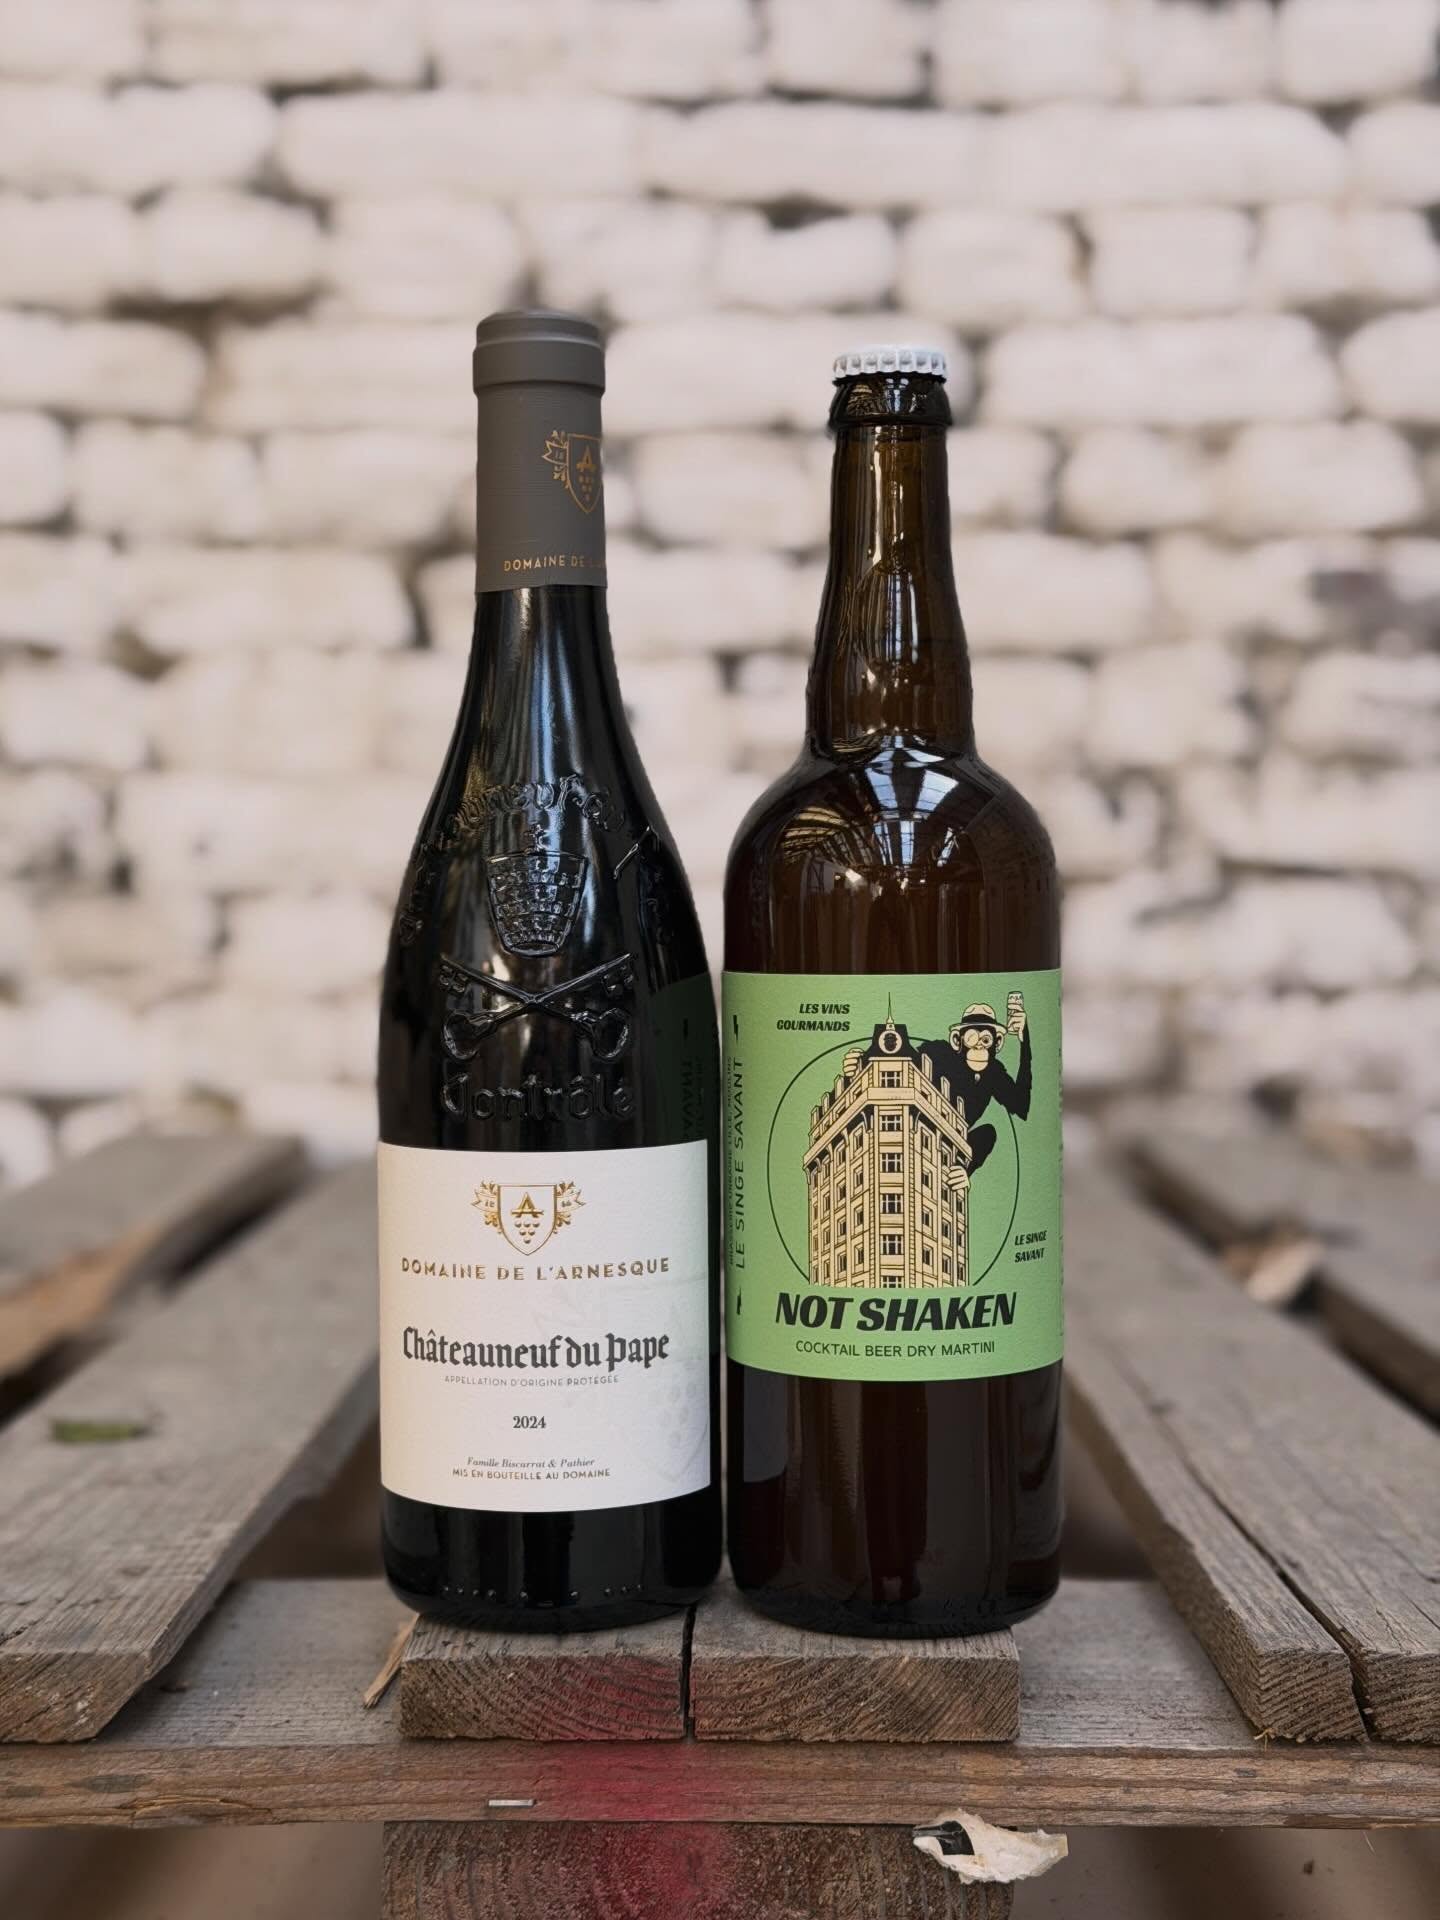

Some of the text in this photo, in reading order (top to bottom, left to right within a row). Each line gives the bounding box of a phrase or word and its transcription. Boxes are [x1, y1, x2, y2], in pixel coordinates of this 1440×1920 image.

[503, 555, 565, 572] DOMAINE
[570, 555, 585, 568] DE
[799, 1003, 850, 1015] LES VINS
[776, 1019, 850, 1032] GOURMANDS
[733, 1057, 745, 1269] LE SINGE SAVANT
[1015, 1229, 1047, 1246] LE SINGE
[1014, 1248, 1045, 1263] SAVANT
[401, 1256, 670, 1280] DOMAINE DE L'ARNESQUE
[776, 1292, 1017, 1332] NOT SHAKEN
[402, 1326, 670, 1373] Châteauneuf du Pape
[796, 1340, 996, 1357] COCKTAIL BEER DRY MARTINI
[444, 1375, 508, 1387] APPELLATION
[510, 1377, 564, 1388] D'ORIGINE
[512, 1415, 547, 1430] 2024
[467, 1456, 500, 1468] Famille
[548, 1458, 557, 1468] &
[452, 1468, 611, 1481] MIS EN BOUTEILLE AU DOMAINE
